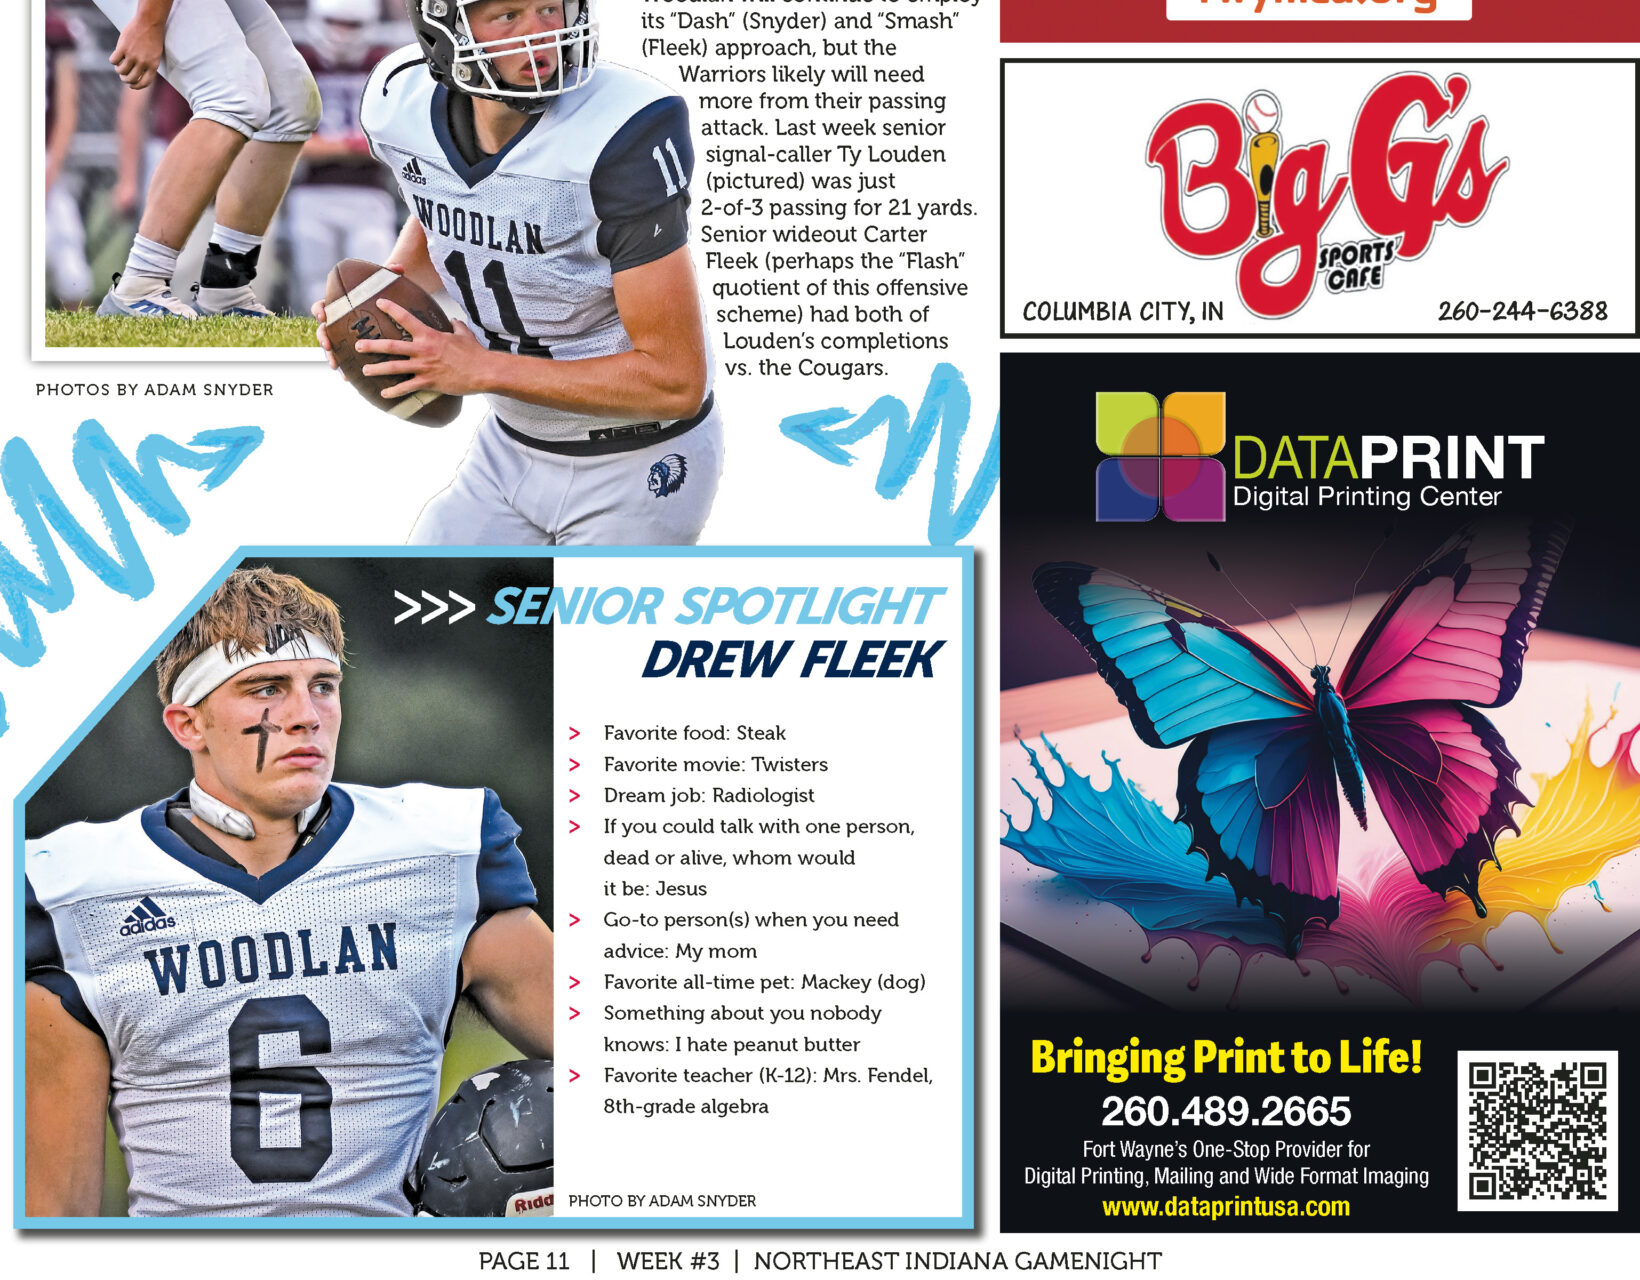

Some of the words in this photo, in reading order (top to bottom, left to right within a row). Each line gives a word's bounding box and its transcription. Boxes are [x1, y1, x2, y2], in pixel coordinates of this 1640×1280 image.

[401, 171, 427, 186] adidas
[652, 137, 688, 198] 11
[413, 194, 546, 255] WOODLAN
[1318, 240, 1394, 268] SPORTS
[1327, 265, 1382, 291] CAFE
[444, 249, 553, 360] 11
[1023, 301, 1131, 321] COLUMBIA
[1140, 301, 1195, 324] CITY,
[1202, 301, 1223, 321] IN
[1438, 301, 1608, 321] 260-244-6388
[725, 363, 751, 376] vs.
[759, 359, 791, 376] the
[799, 359, 888, 380] Cougars.
[36, 384, 109, 395] PHOTOS
[117, 384, 138, 395] BY
[144, 384, 196, 395] ADAM
[204, 384, 273, 395] SNYDER
[1235, 435, 1545, 479] DATAPRINT
[1234, 486, 1308, 511] Digital
[1319, 486, 1410, 511] Printing
[1421, 486, 1502, 506] Center
[486, 586, 665, 625] SENIOR
[674, 586, 949, 625] SPOTLIGHT
[642, 640, 795, 678] DREW
[800, 640, 947, 678] FLEEK
[605, 725, 677, 740] Favorite
[684, 725, 729, 740] food:
[737, 725, 786, 740] Steak
[119, 915, 176, 937] adidas
[143, 922, 398, 996] WOODLAN
[604, 943, 668, 958] advice:
[676, 943, 703, 962] My
[709, 947, 757, 958] mom
[1032, 1037, 1186, 1083] Bringing
[1194, 1037, 1285, 1073] Print
[1291, 1041, 1331, 1073] to
[1341, 1037, 1421, 1073] Life!
[228, 994, 333, 1184] 6
[604, 1098, 695, 1118] 8th-grade
[701, 1098, 769, 1118] algebra
[1102, 1096, 1351, 1126] 260.489.2665
[1084, 1141, 1115, 1158] Fort
[1120, 1141, 1187, 1161] Wayne's
[1193, 1140, 1270, 1161] One-Stop
[1276, 1141, 1343, 1158] Provider
[1348, 1140, 1370, 1158] for
[1025, 1167, 1075, 1188] Digital
[1082, 1167, 1148, 1188] Printing,
[1155, 1167, 1213, 1188] Mailing
[1219, 1167, 1249, 1184] and
[1254, 1167, 1294, 1184] Wide
[1301, 1167, 1358, 1184] Format
[1364, 1167, 1428, 1188] Imaging
[569, 1195, 623, 1207] PHOTO
[628, 1195, 645, 1207] BY
[649, 1195, 693, 1207] ADAM
[698, 1195, 756, 1207] SNYDER
[1102, 1195, 1350, 1220] www.dataprintusa.com
[479, 1252, 539, 1270] PAGE
[547, 1252, 569, 1270] 11
[617, 1252, 682, 1270] WEEK
[691, 1252, 719, 1270] #3
[755, 1252, 899, 1270] NORTHEAST
[906, 1252, 1008, 1270] INDIANA
[1015, 1252, 1162, 1270] GAMENIGHT
